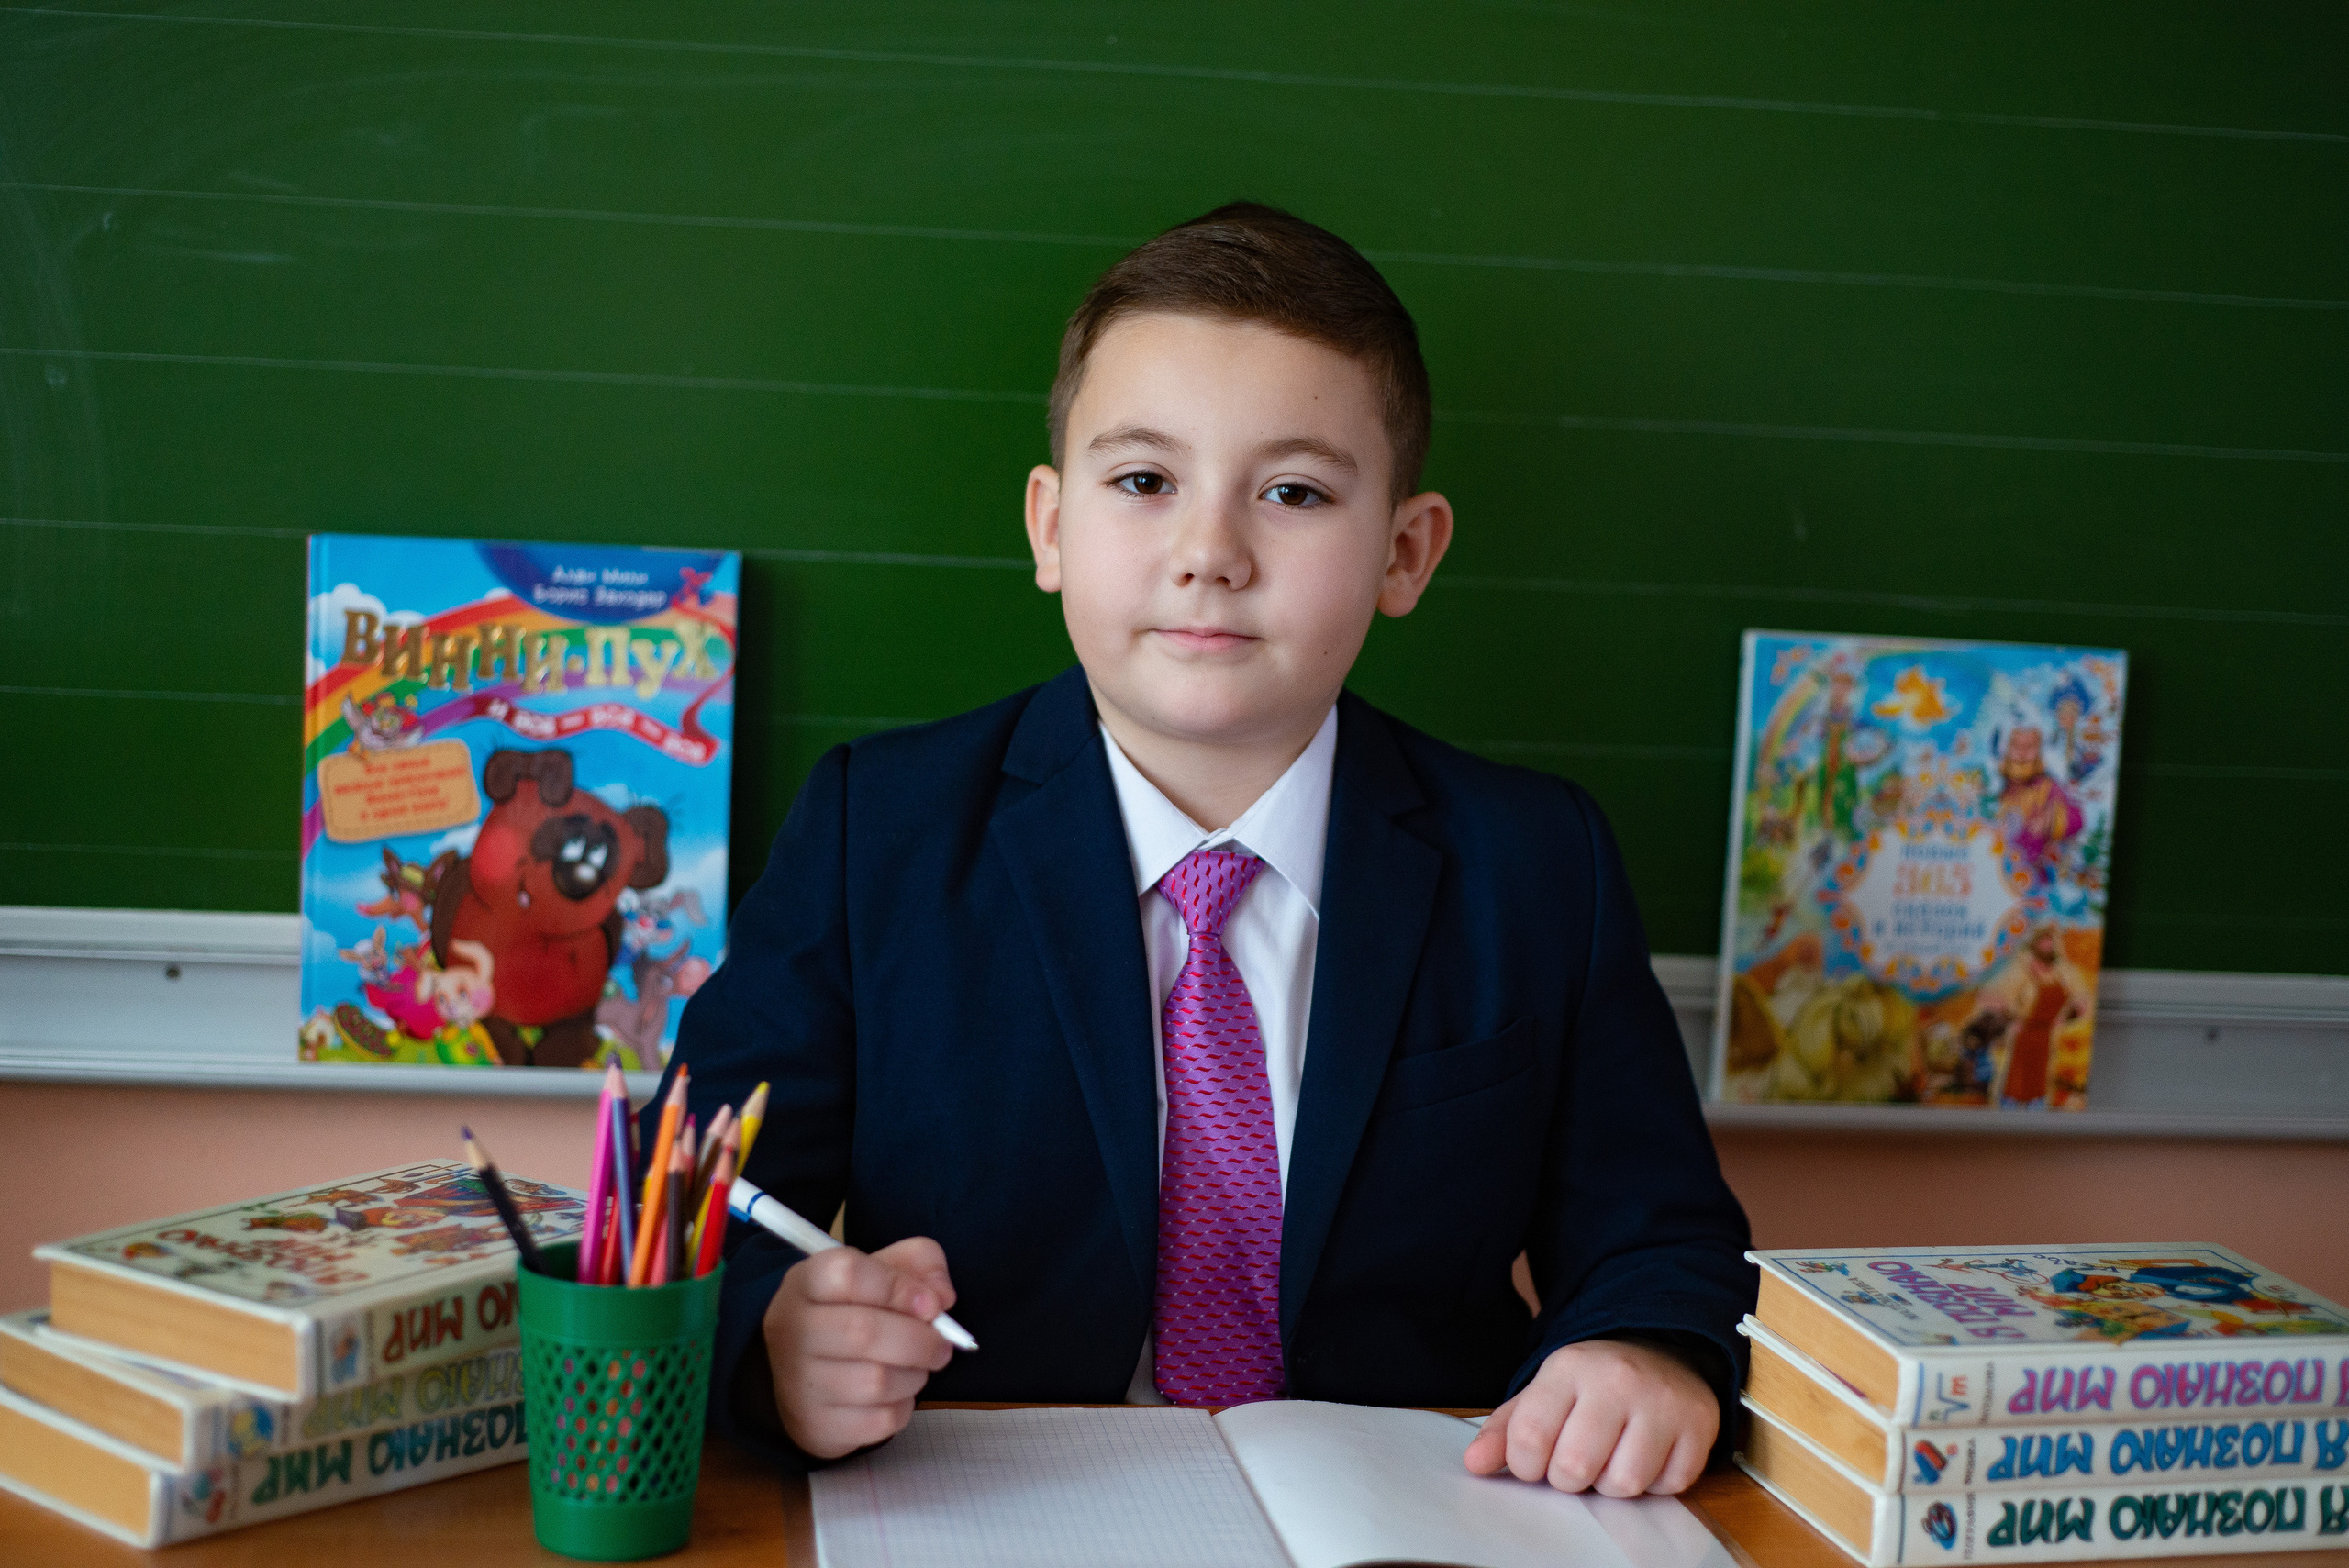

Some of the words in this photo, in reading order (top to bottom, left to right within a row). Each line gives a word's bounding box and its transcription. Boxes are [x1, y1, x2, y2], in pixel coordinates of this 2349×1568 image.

[382, 1296, 465, 1364] МИР
[2007, 1365, 2117, 1415] МИР
[2129, 1359, 2325, 1410] ПОЗНАЮ
[1987, 1431, 2095, 1482] МИР
[2110, 1421, 2306, 1475] ПОЗНАЮ
[2316, 1420, 2349, 1470] Я
[251, 1439, 353, 1507] МИР
[1986, 1497, 2096, 1548] МИР
[2109, 1486, 2307, 1541] ПОЗНАЮ
[2318, 1485, 2349, 1536] Я
